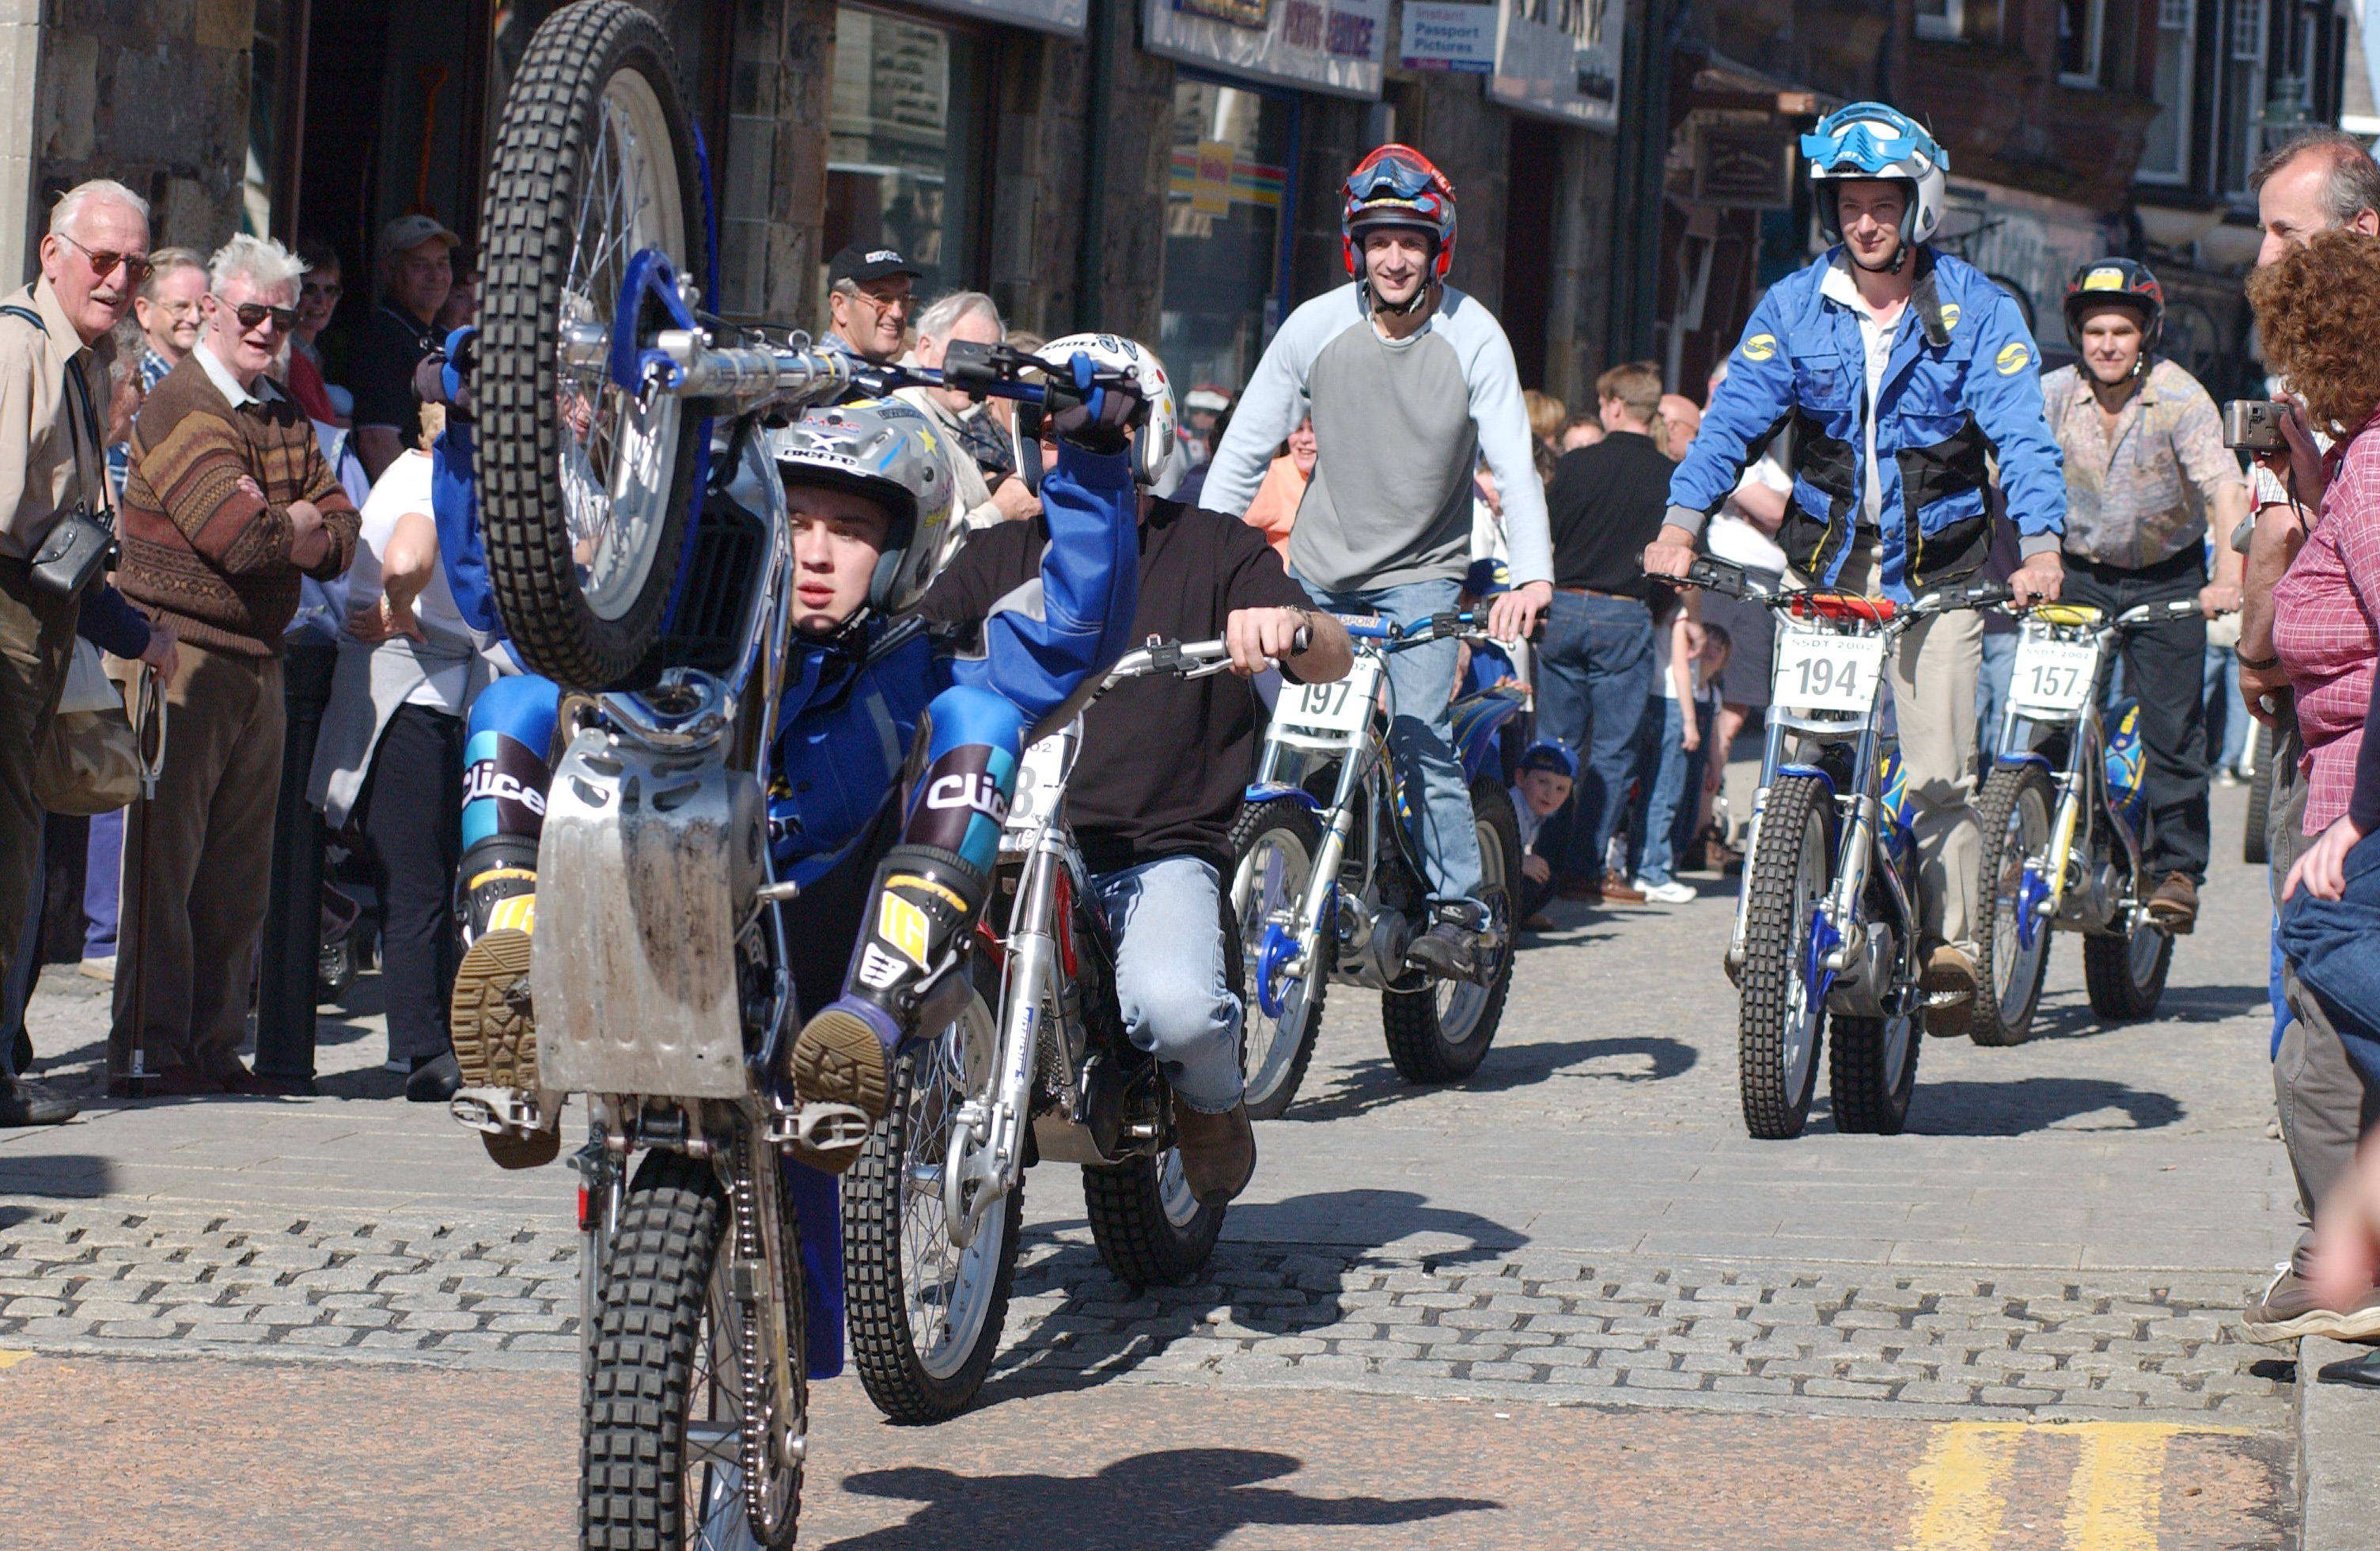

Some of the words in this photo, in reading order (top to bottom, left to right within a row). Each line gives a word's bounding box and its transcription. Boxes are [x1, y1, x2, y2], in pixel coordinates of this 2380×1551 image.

[1415, 8, 1465, 21] Instant
[1415, 21, 1479, 38] Passport
[1414, 36, 1472, 53] Pictures
[1040, 340, 1097, 353] SHOEI
[1791, 639, 1830, 648] SSDT
[1837, 641, 1874, 651] 2002
[1796, 658, 1857, 697] 194
[2031, 665, 2079, 697] 157
[1300, 681, 1353, 716] 197
